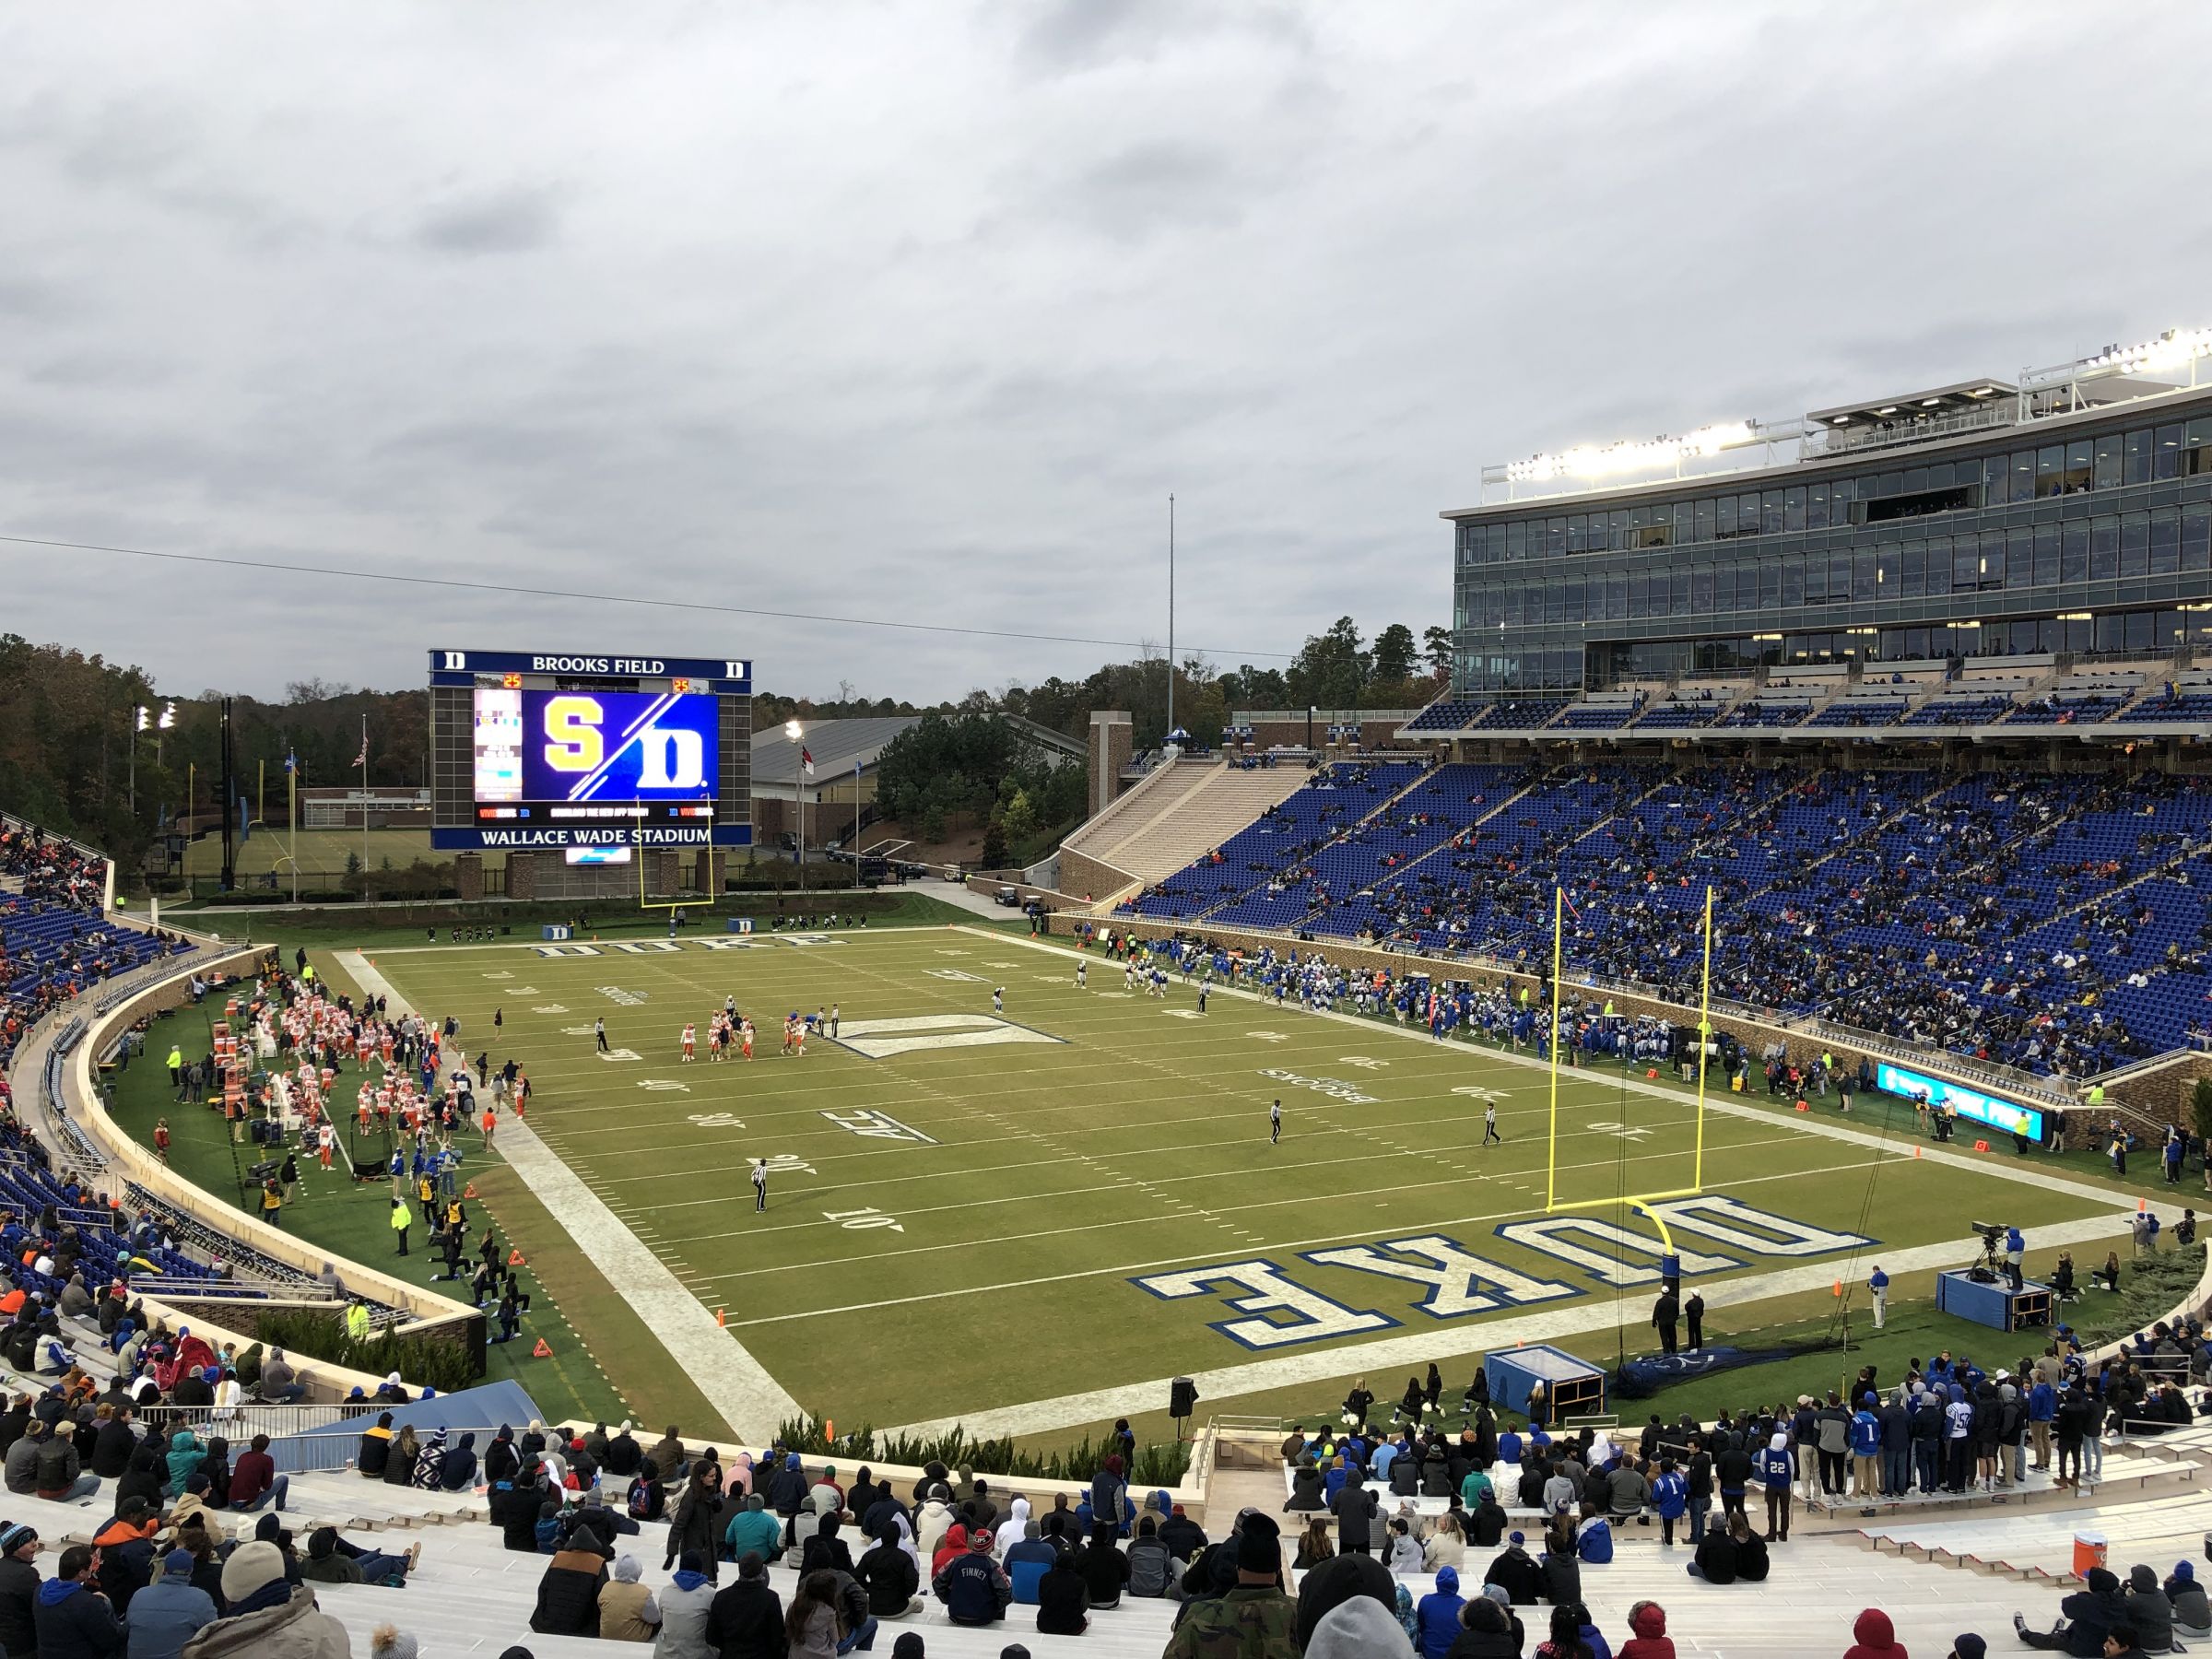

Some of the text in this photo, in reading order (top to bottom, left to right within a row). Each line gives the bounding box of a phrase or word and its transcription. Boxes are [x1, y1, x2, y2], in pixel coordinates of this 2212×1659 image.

[444, 652, 465, 670] D
[533, 656, 665, 675] BROOKS FIELD
[725, 662, 744, 679] D
[504, 675, 521, 687] 25
[674, 679, 688, 692] 25
[544, 696, 604, 772] S
[481, 829, 712, 845] WALLACE WADE STADIUM
[529, 934, 853, 959] DUKE
[1256, 1068, 1382, 1103] BROOKS
[821, 1206, 896, 1230] 10
[1126, 1193, 1882, 1352] DUKE
[1865, 1424, 1875, 1441] 1
[1770, 1461, 1786, 1474] 22
[1668, 1477, 1679, 1495] 1
[960, 1567, 987, 1582] FINNEY
